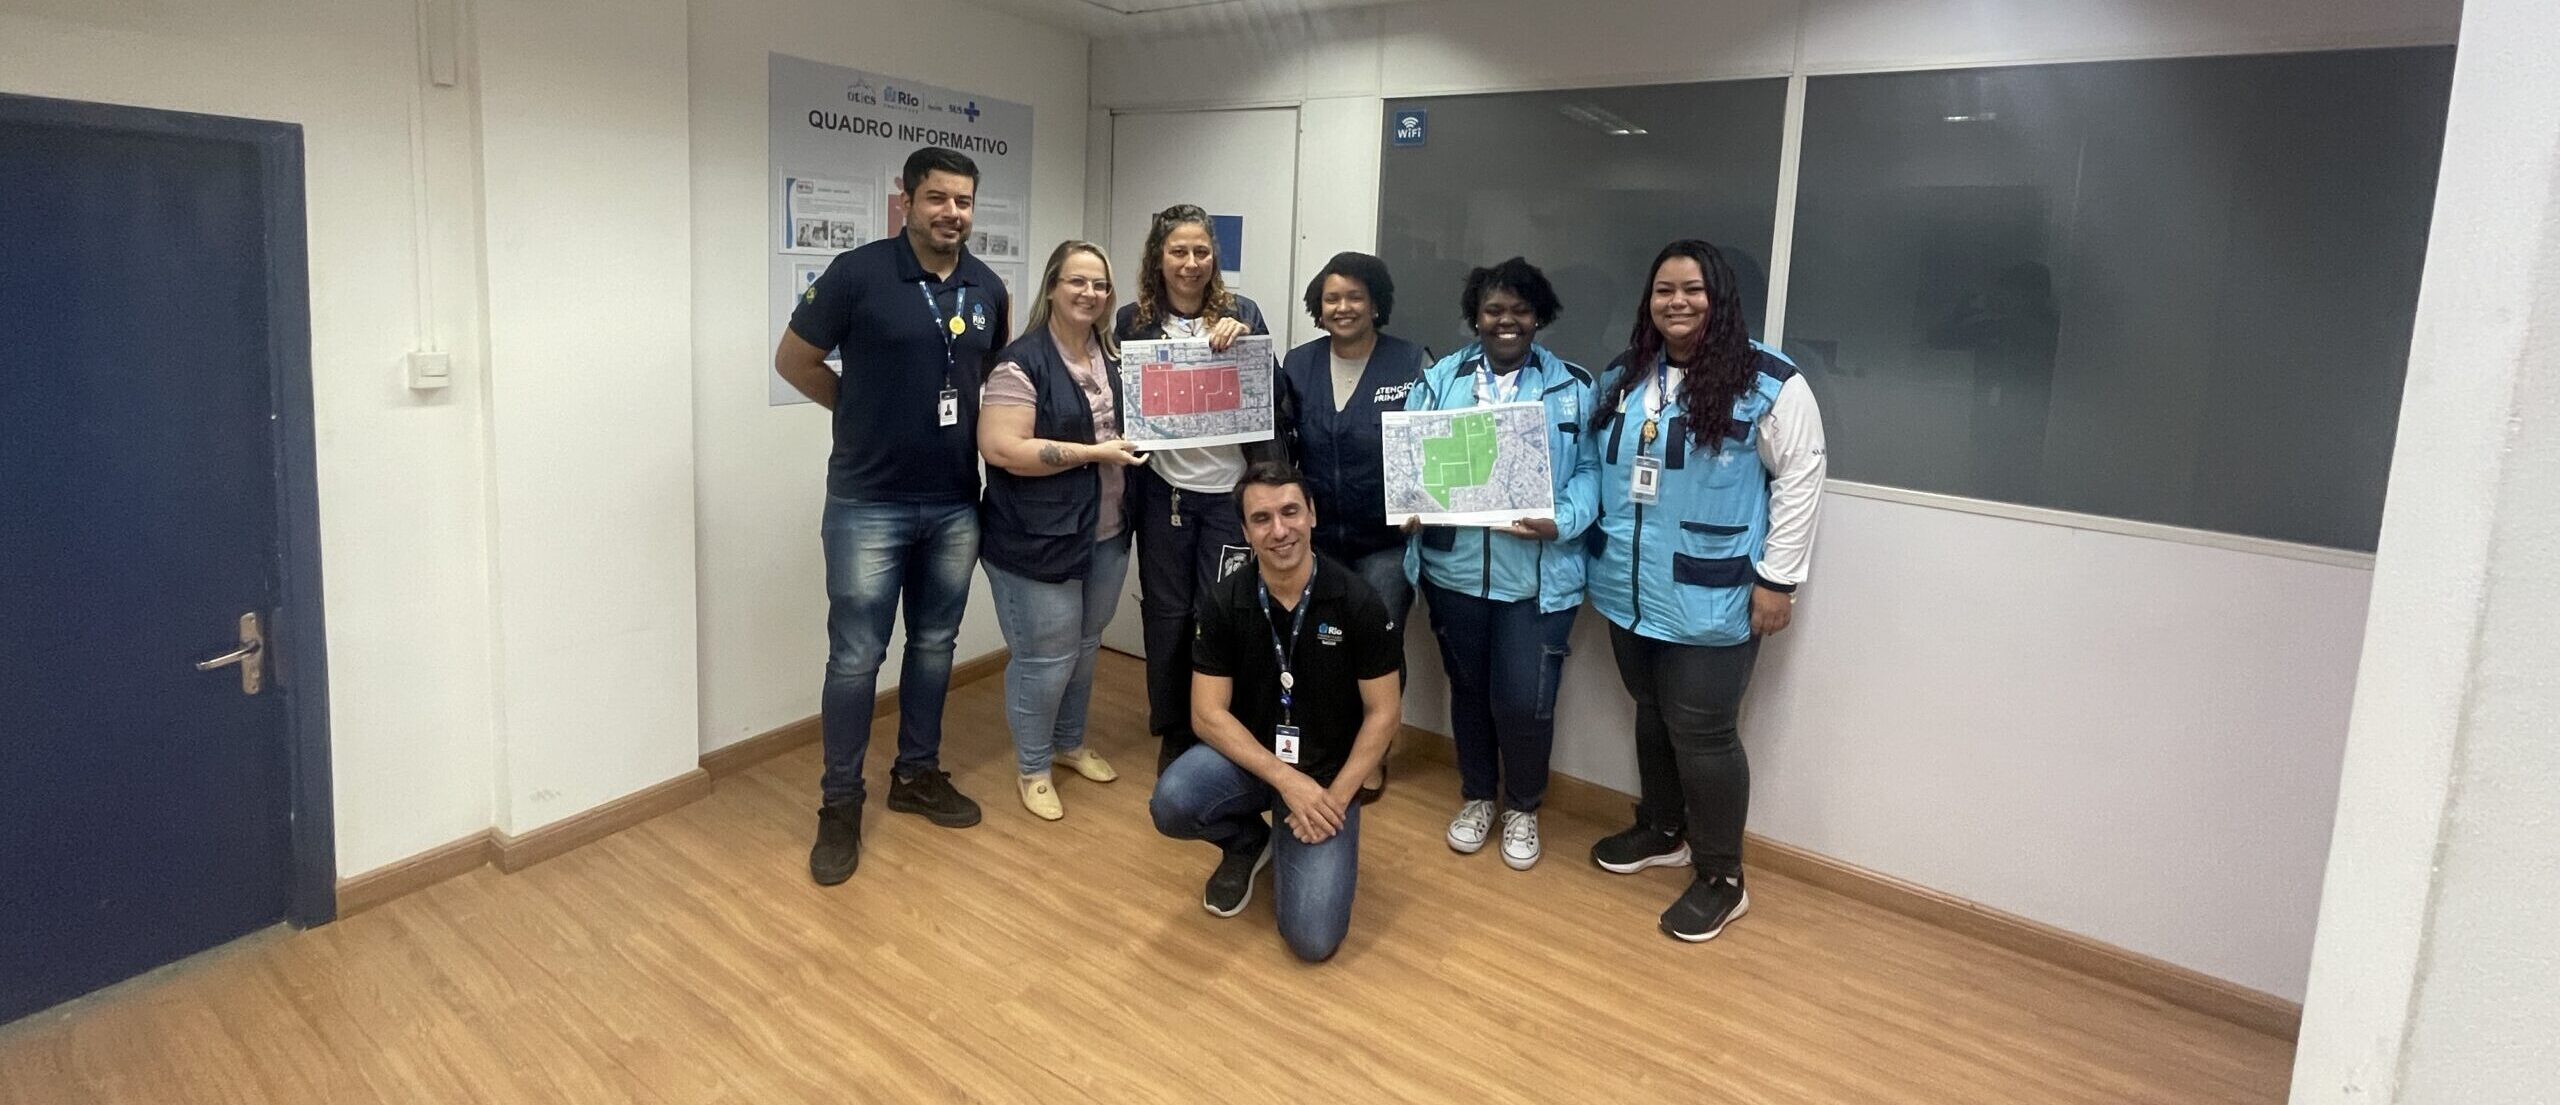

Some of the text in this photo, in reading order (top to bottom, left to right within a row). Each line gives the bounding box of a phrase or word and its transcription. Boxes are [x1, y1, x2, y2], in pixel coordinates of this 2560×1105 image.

[898, 91, 919, 107] Rio
[808, 109, 1008, 156] QUADRO INFORMATIVO
[1397, 128, 1421, 139] WiFi
